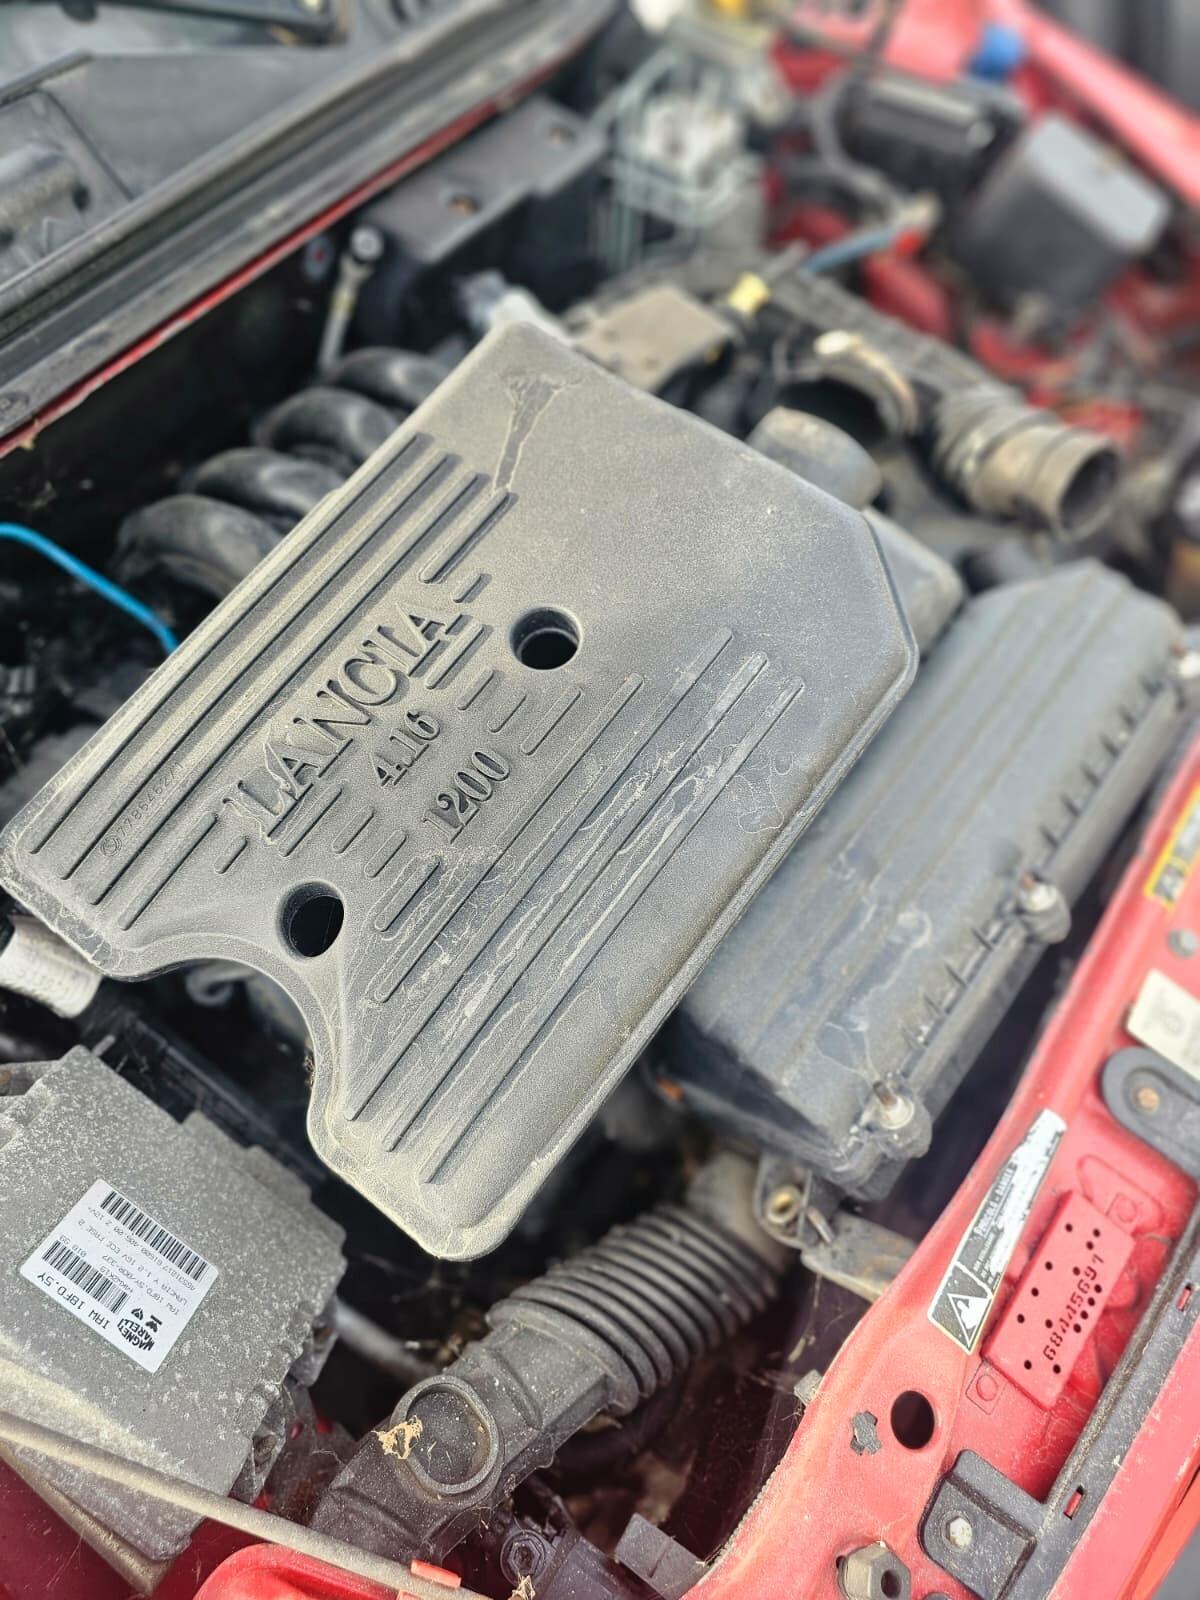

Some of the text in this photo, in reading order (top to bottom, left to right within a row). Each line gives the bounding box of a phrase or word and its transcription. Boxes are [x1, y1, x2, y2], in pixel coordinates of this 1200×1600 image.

[222, 603, 447, 842] LANCIA
[369, 710, 441, 787] 4.16
[422, 750, 511, 845] 1200
[88, 1309, 111, 1330] IAW
[161, 1283, 188, 1306] LANCIA
